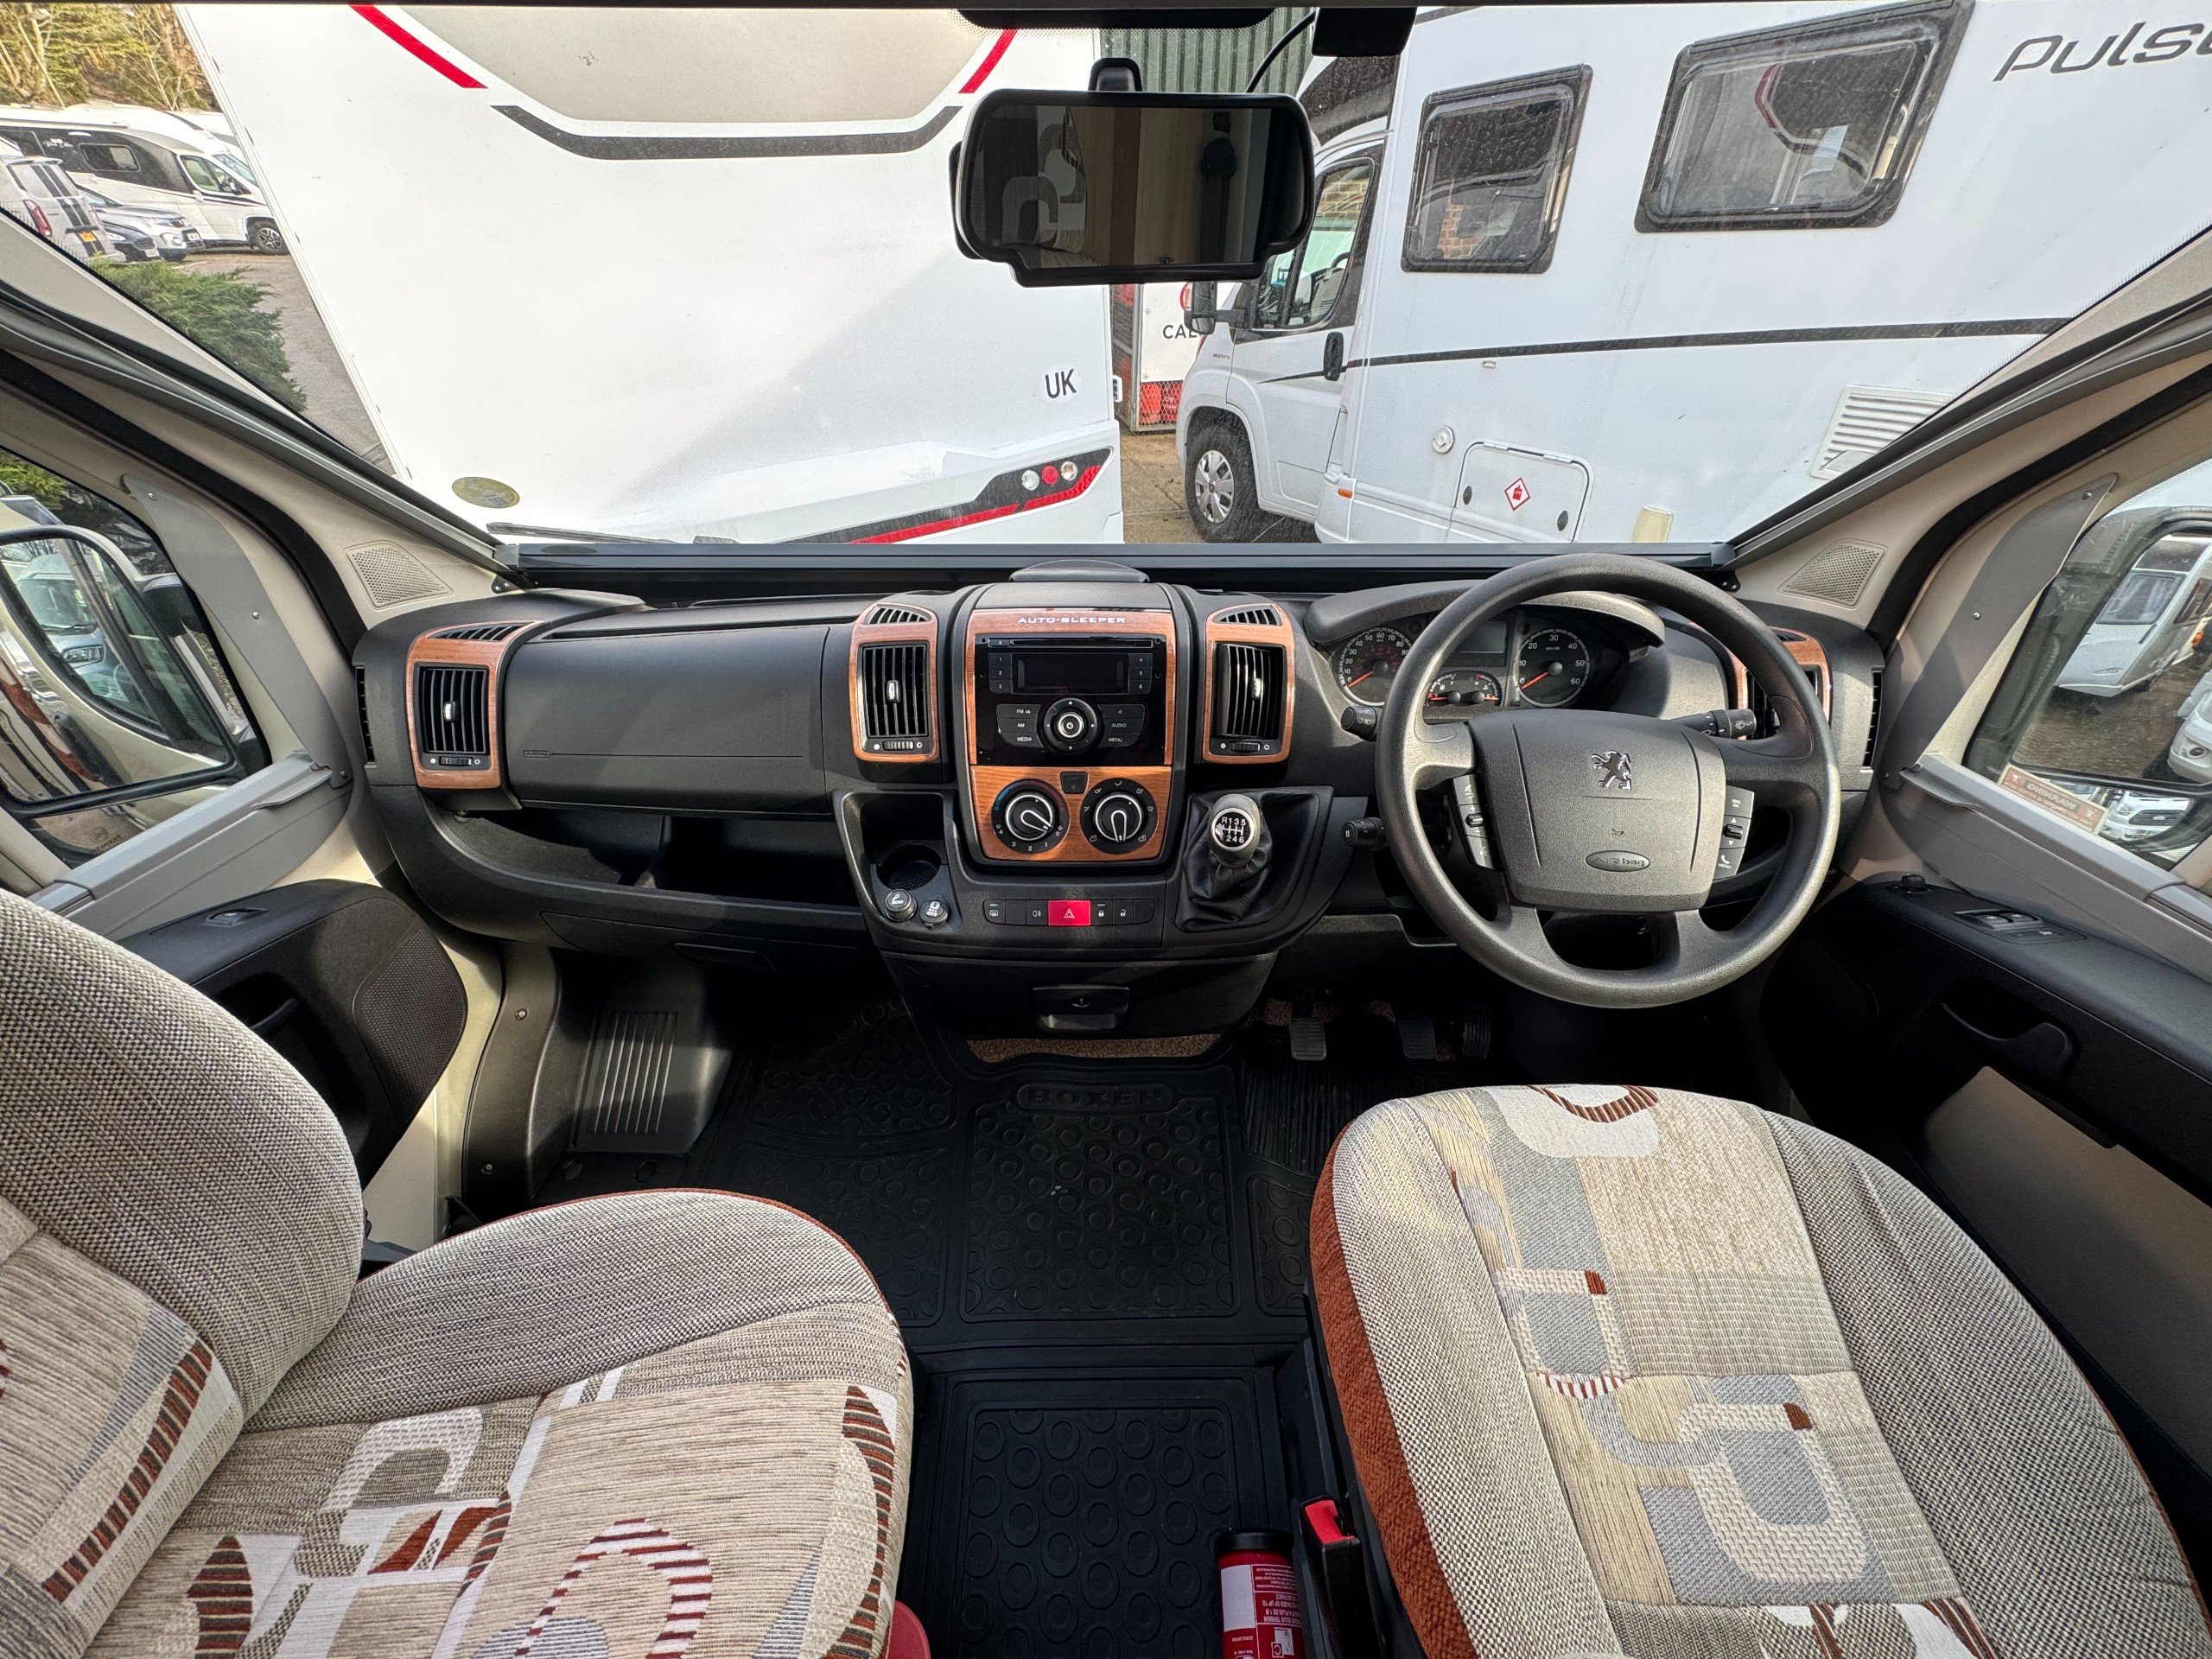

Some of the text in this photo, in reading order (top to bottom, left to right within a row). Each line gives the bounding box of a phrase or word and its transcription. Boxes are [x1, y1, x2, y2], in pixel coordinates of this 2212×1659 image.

[1162, 323, 1202, 340] CAL
[1045, 368, 1077, 399] UK
[1221, 816, 1228, 824] R
[1592, 857, 1644, 868] AIRbag
[1027, 1088, 1163, 1107] BOXER
[1274, 1643, 1281, 1656] C
